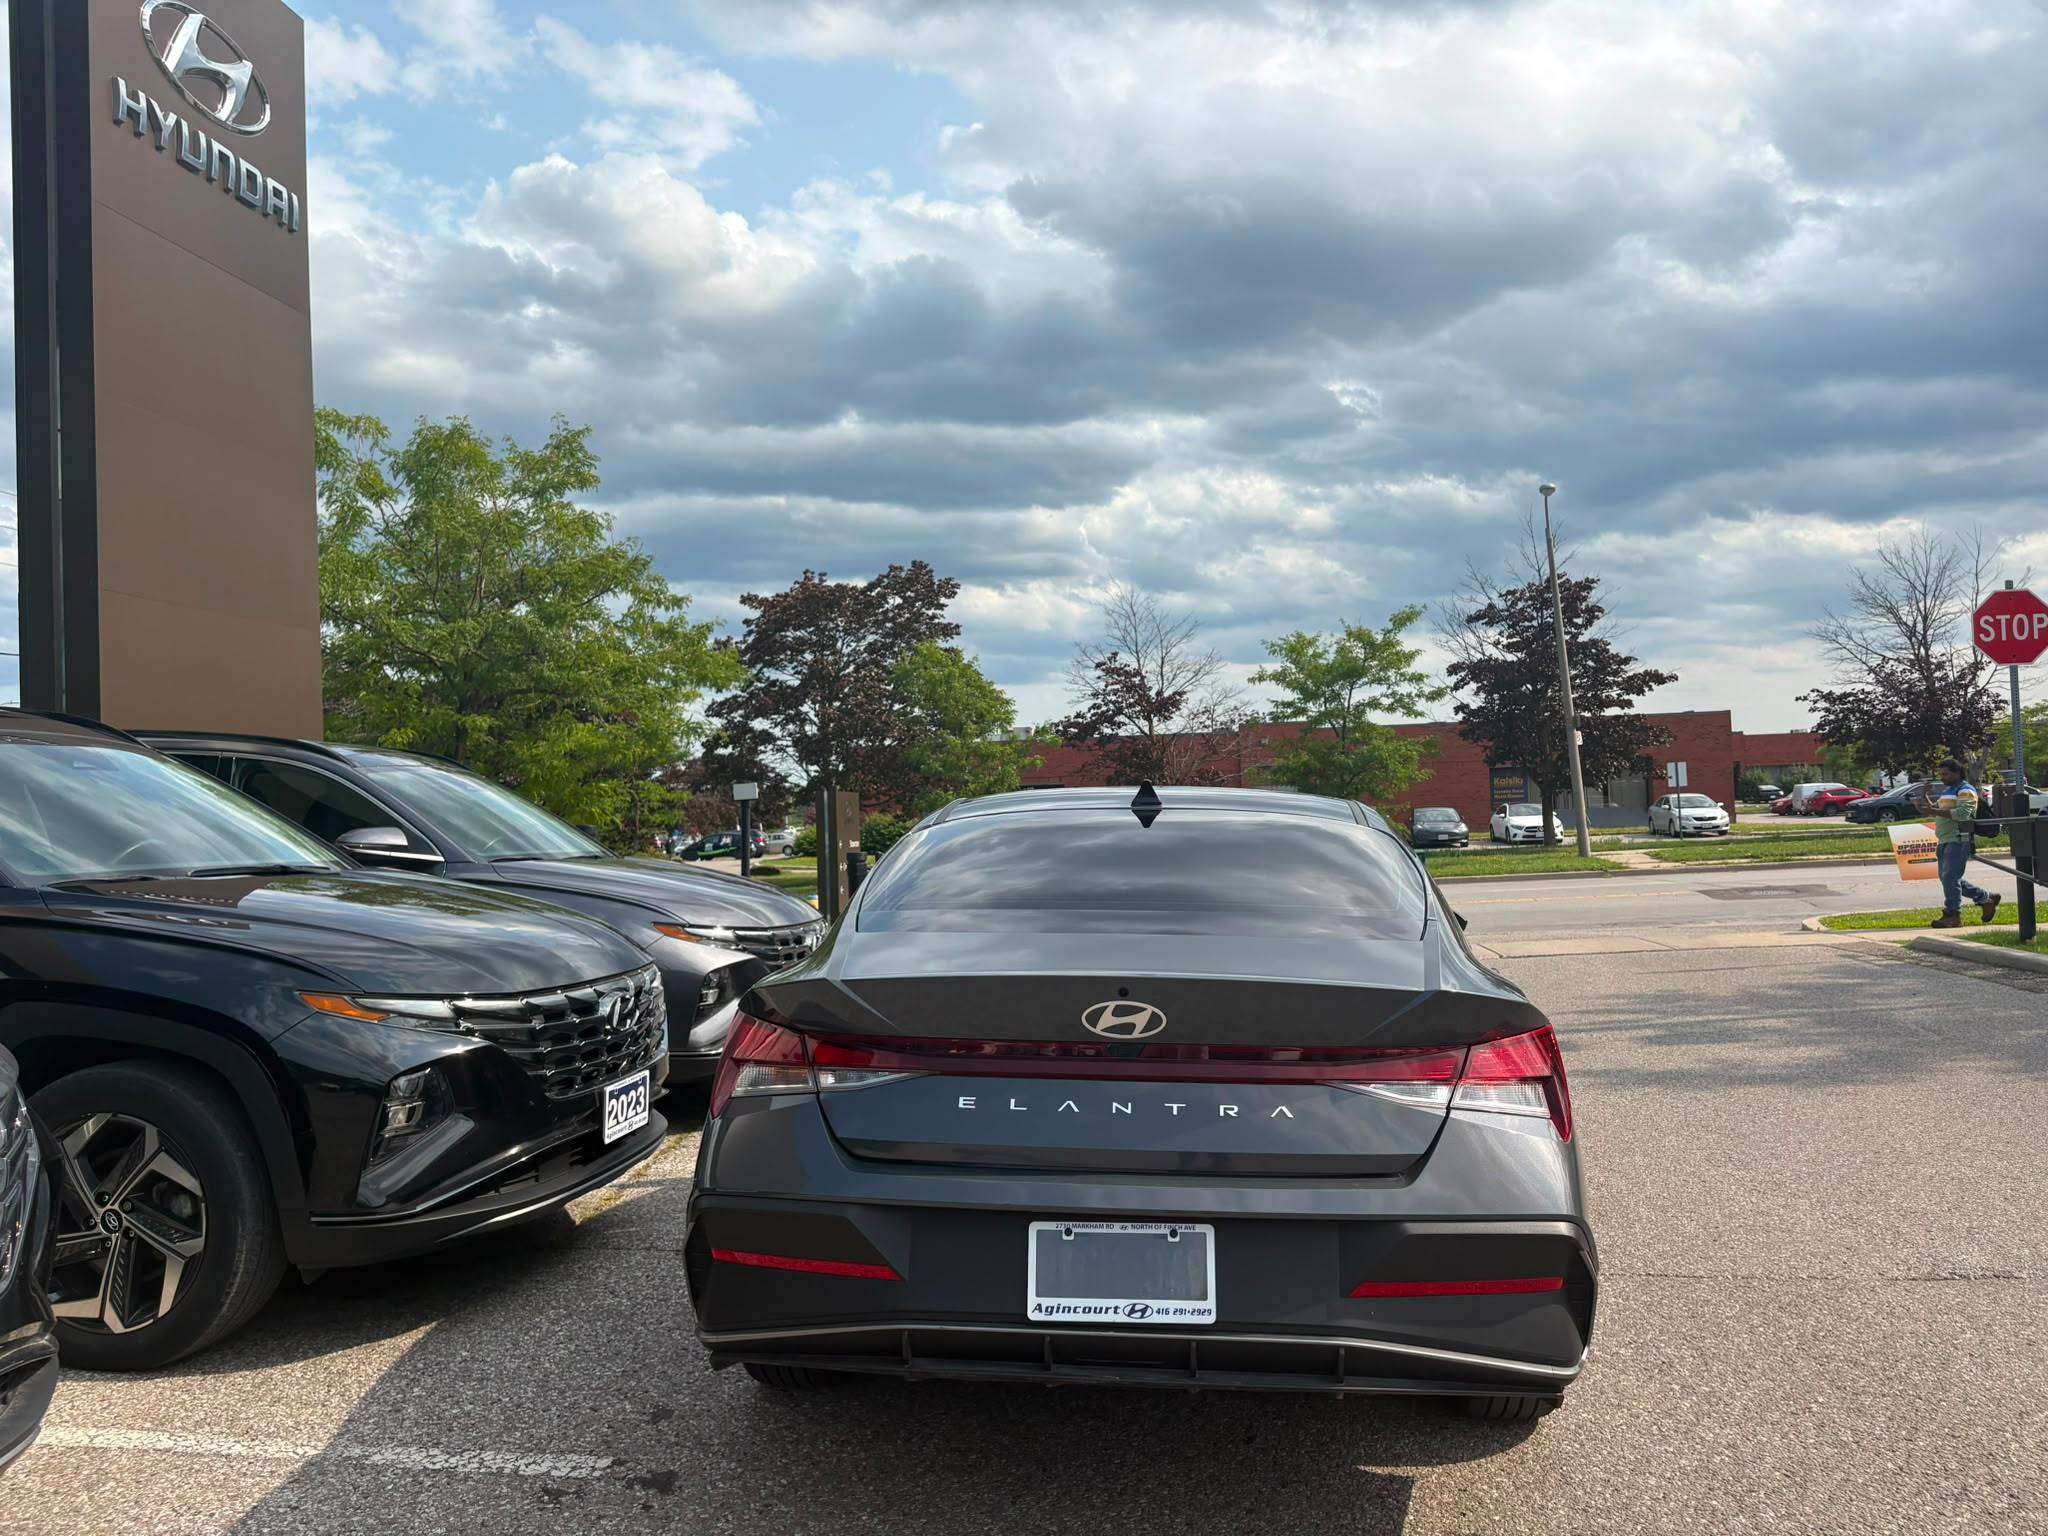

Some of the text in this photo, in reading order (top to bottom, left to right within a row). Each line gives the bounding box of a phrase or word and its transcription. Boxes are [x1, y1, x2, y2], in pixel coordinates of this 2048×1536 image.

[112, 76, 299, 233] HYUNDAI
[1980, 613, 2048, 642] STOP
[608, 1085, 645, 1128] 2023
[958, 1096, 1294, 1118] ELANTRA
[1032, 1303, 1120, 1316] Agincourt
[1155, 1308, 1170, 1316] 416
